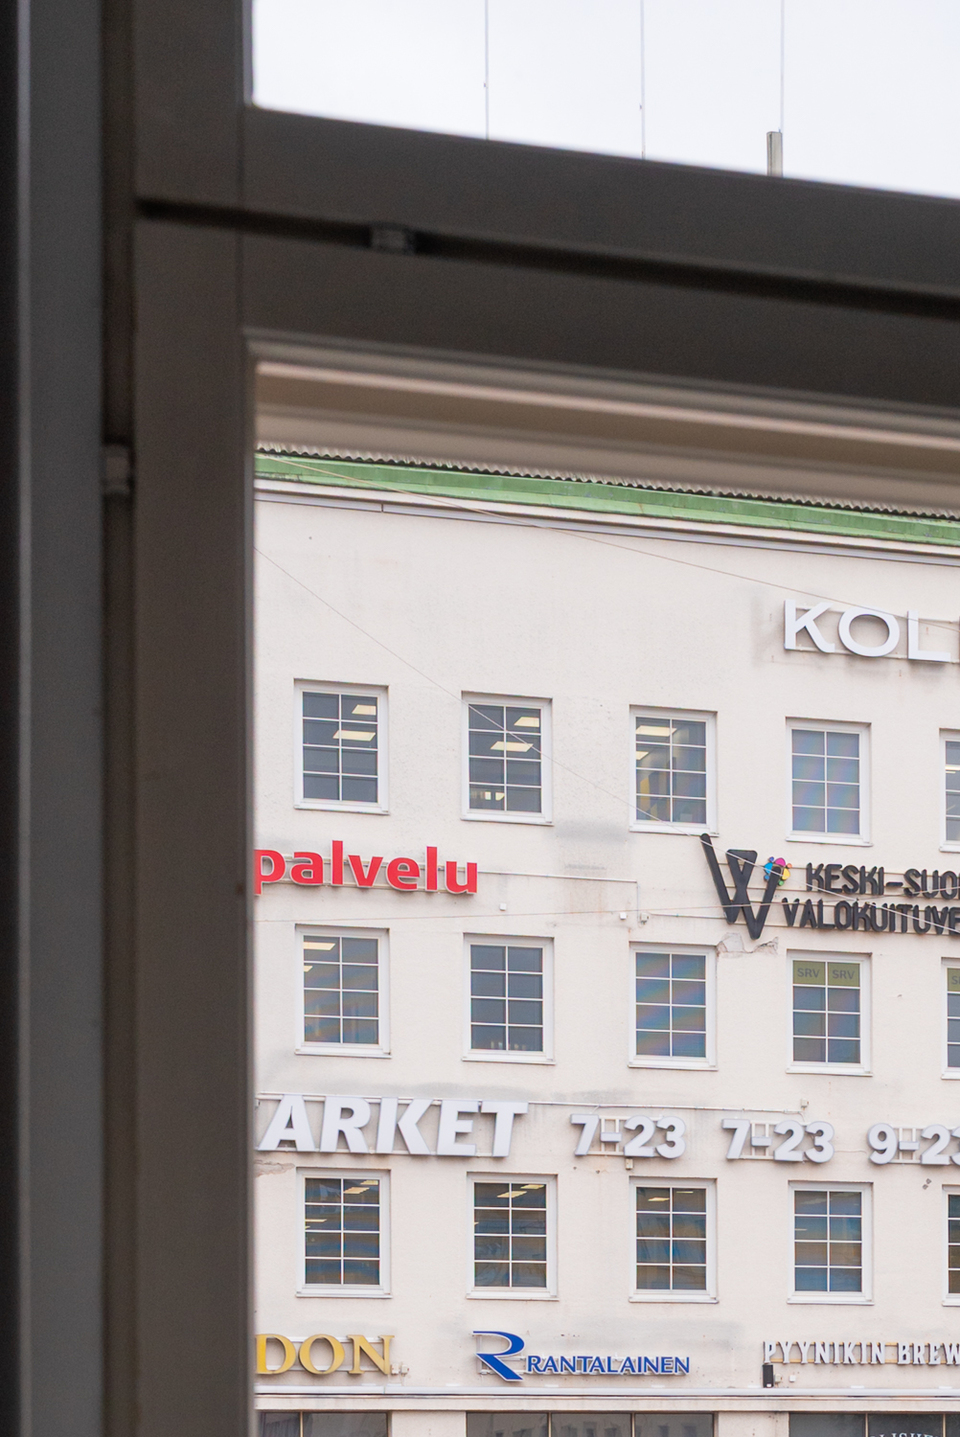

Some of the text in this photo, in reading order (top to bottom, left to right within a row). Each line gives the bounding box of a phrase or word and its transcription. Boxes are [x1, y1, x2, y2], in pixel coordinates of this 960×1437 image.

[254, 839, 478, 895] palvelu
[797, 966, 820, 979] SRV
[832, 969, 855, 981] SRV
[258, 1094, 529, 1158] ARKET
[570, 1114, 687, 1159] 7-23
[721, 1118, 835, 1164] 7-23
[255, 1333, 395, 1375] DON
[763, 1341, 885, 1365] PYYNIKIN
[526, 1354, 690, 1377] RANTALAINEN
